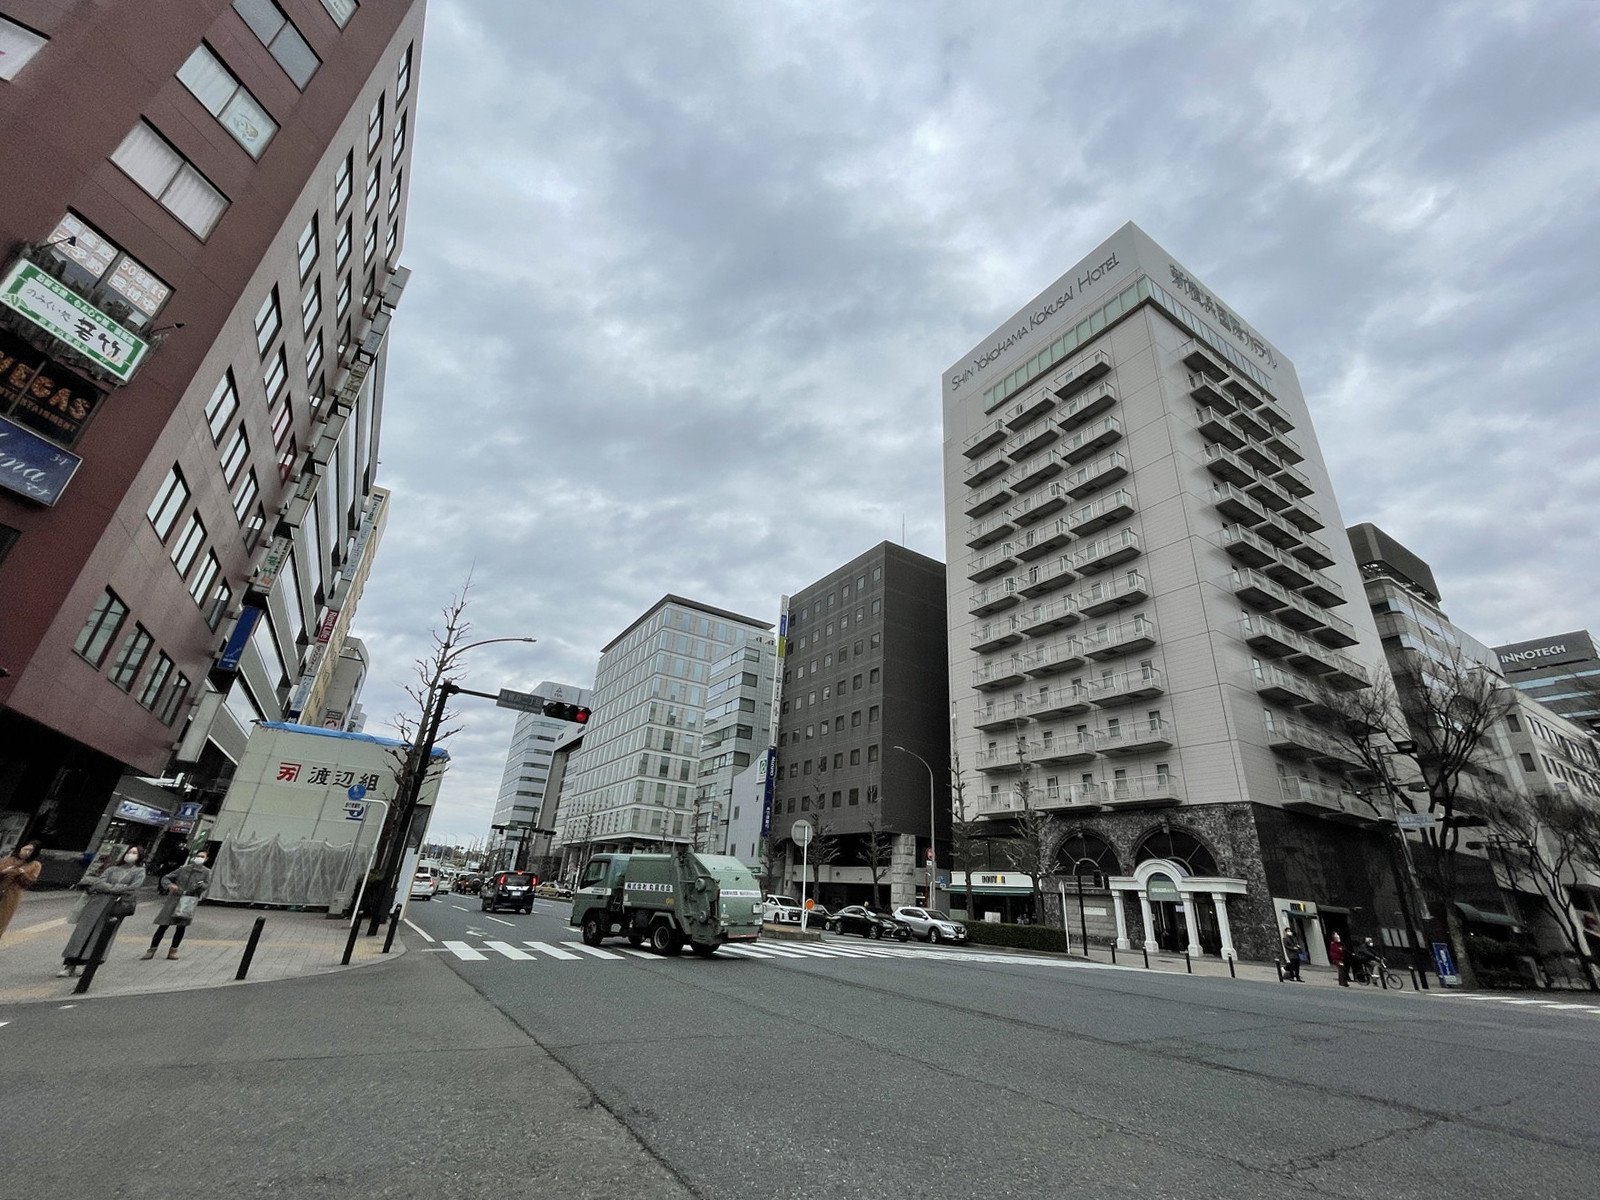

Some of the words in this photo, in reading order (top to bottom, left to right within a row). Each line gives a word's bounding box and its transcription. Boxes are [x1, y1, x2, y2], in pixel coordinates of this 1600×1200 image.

[951, 367, 974, 391] SHIN
[974, 326, 1029, 372] YOKOHAMA
[1029, 285, 1074, 331] KOKUSAI
[1077, 252, 1120, 293] HOTEL
[1501, 644, 1566, 663] INNOTECH
[307, 766, 380, 791] 渡辺組
